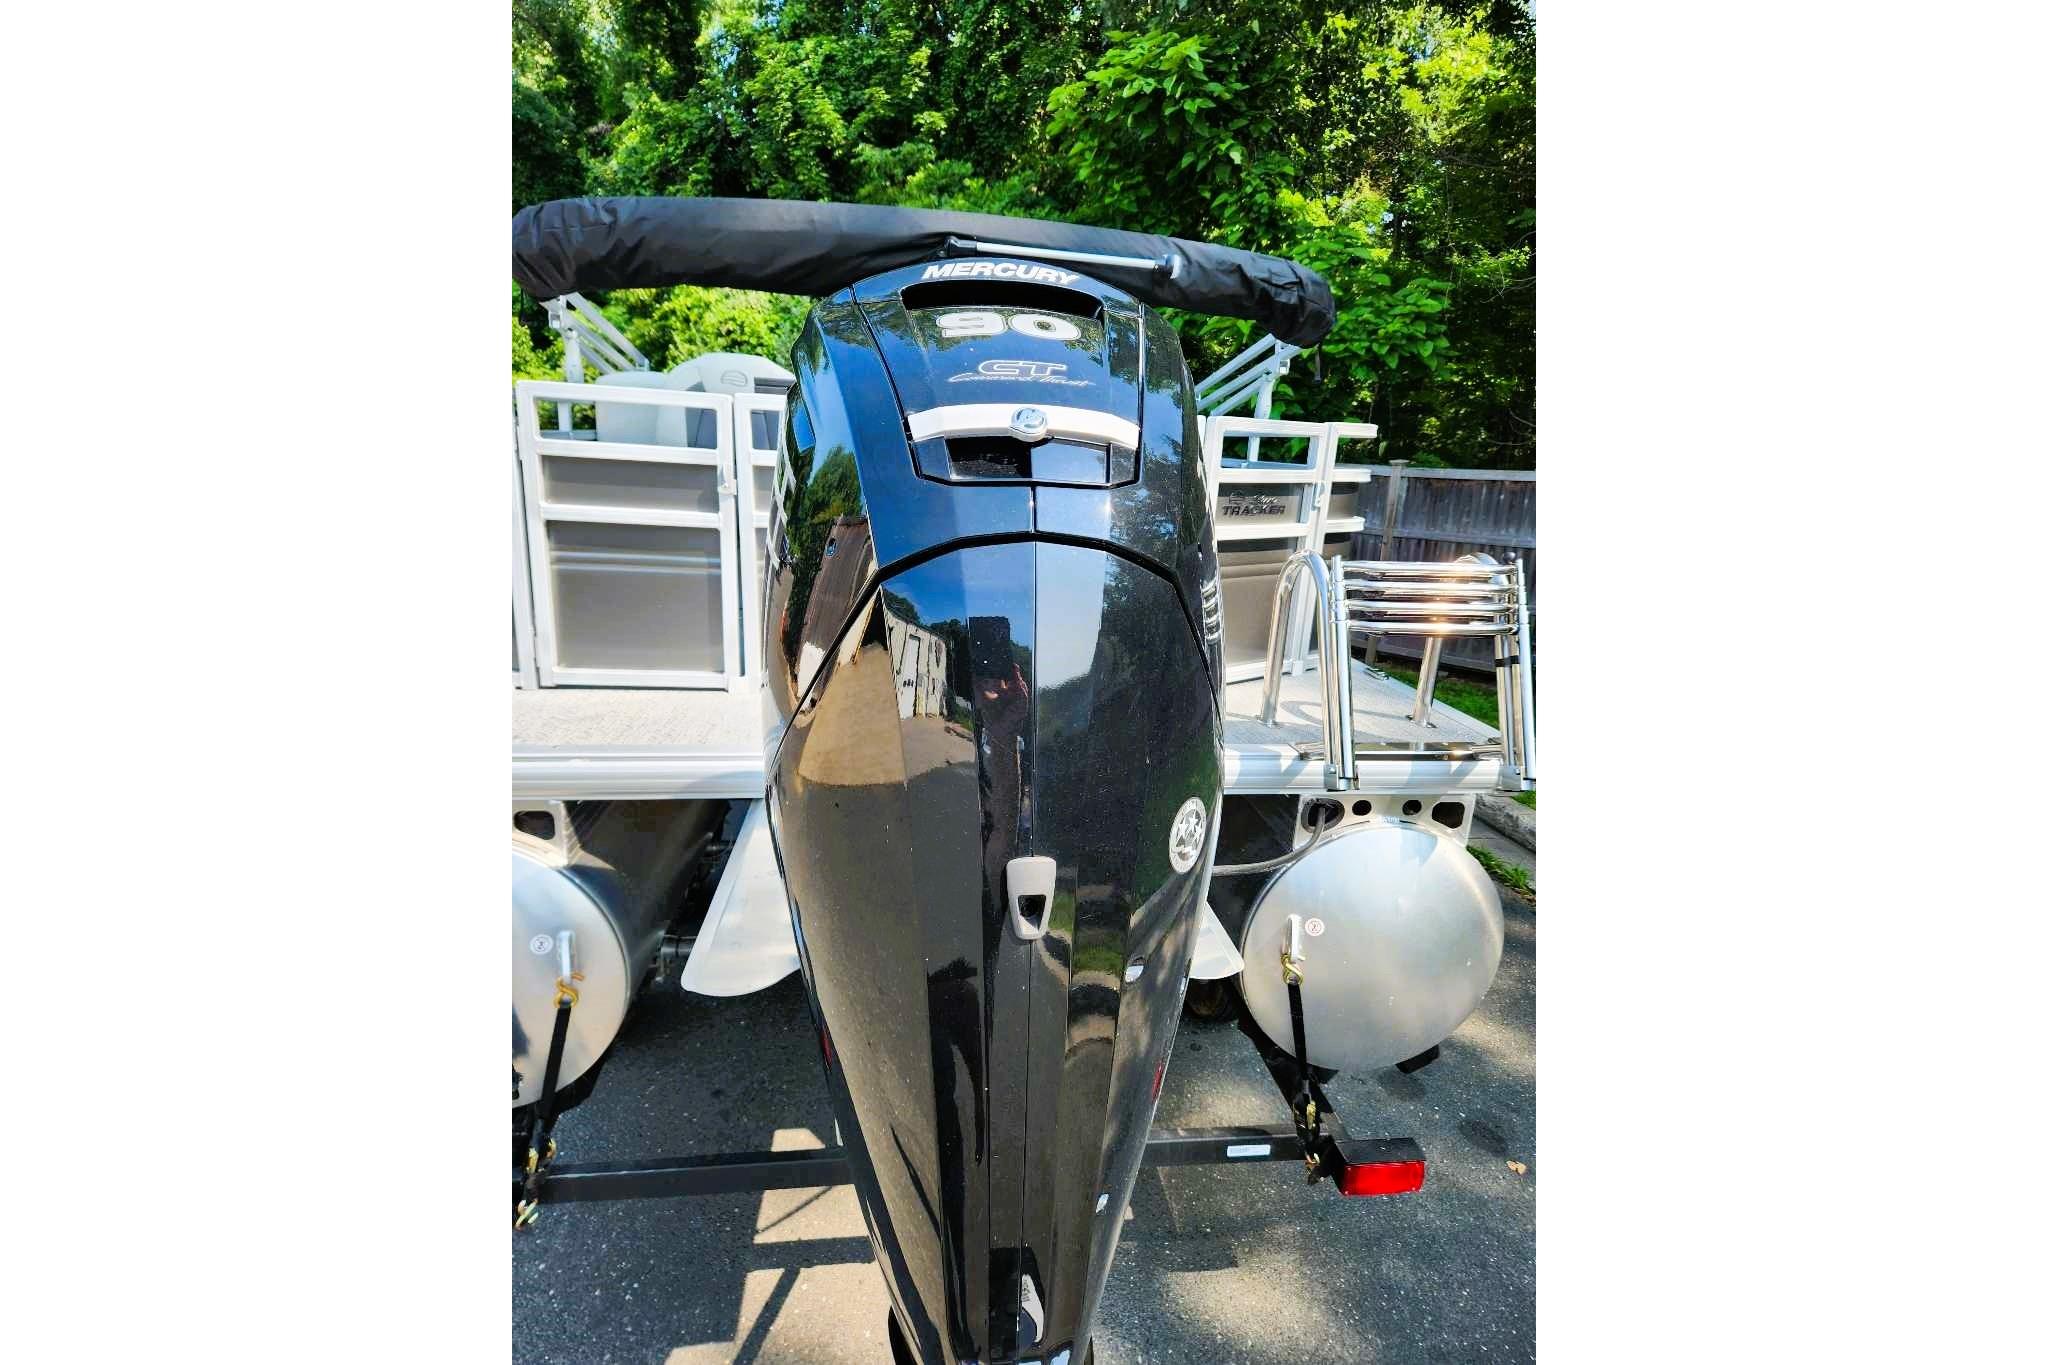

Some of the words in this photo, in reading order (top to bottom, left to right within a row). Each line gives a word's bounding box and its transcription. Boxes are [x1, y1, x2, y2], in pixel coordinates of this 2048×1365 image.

[922, 262, 1080, 285] MERCURY
[936, 311, 1081, 341] 90
[1222, 504, 1286, 516] TRACKER
